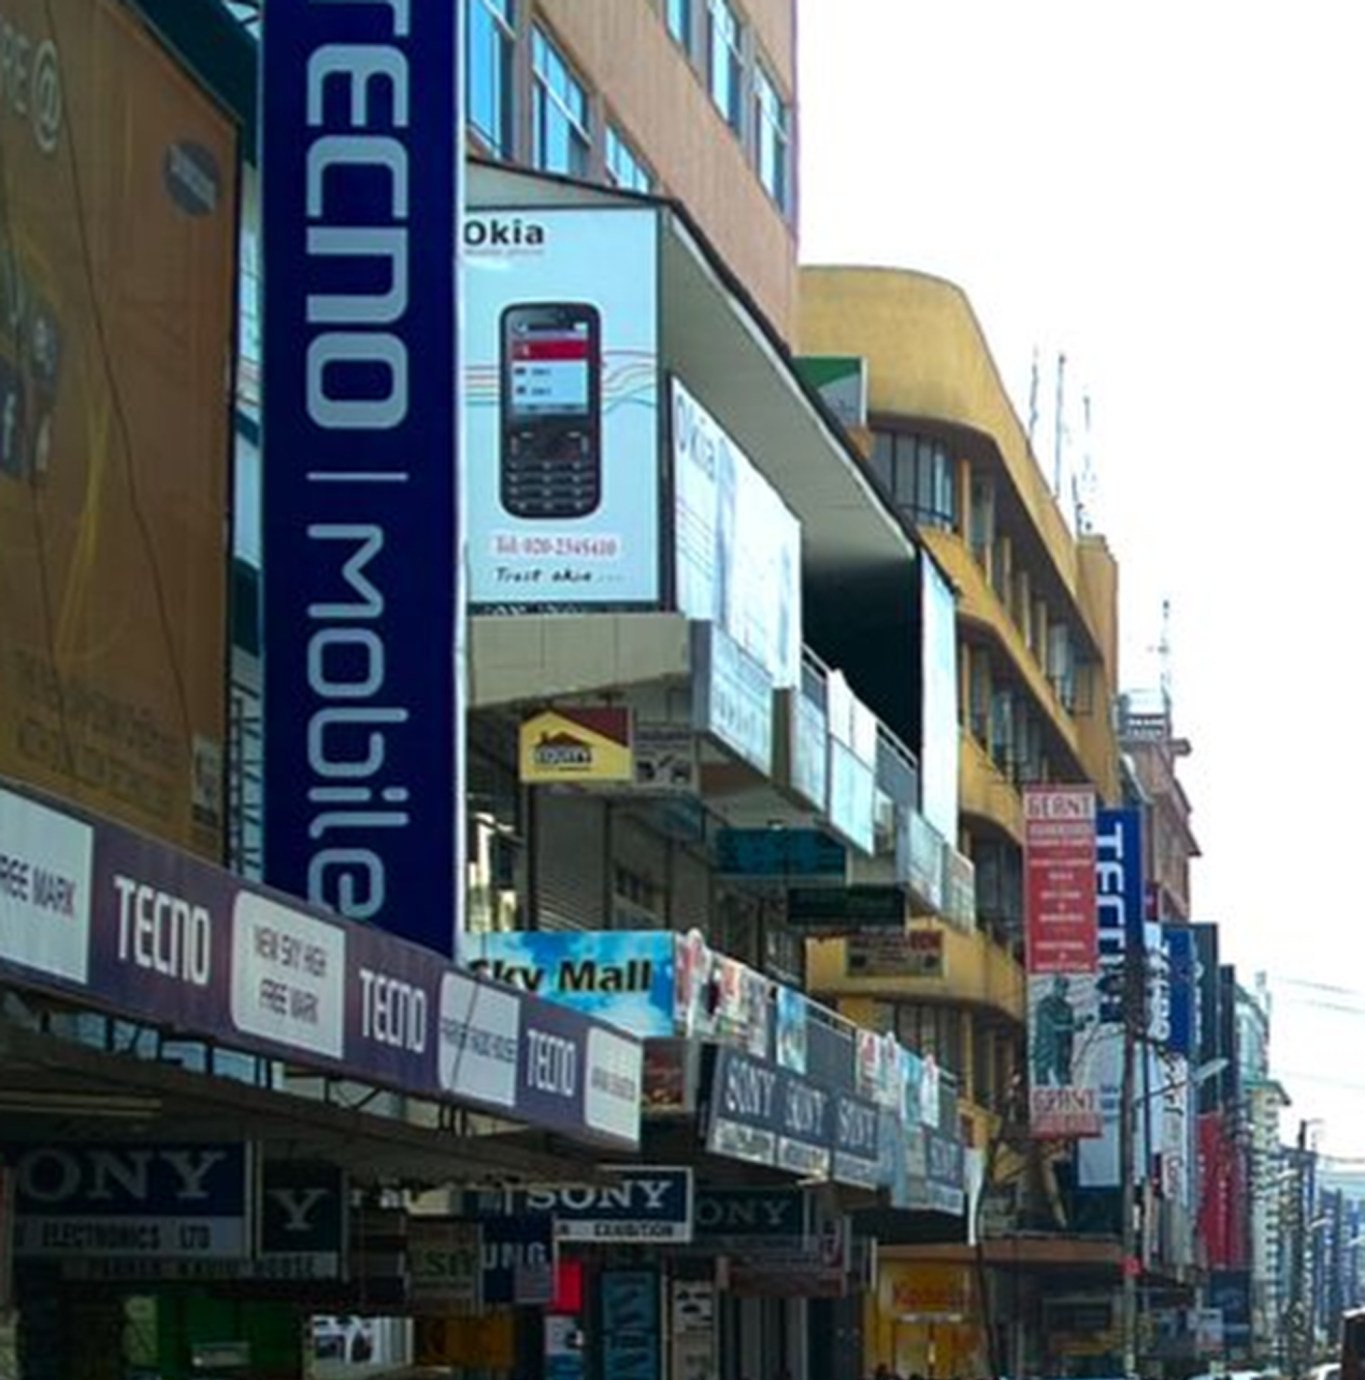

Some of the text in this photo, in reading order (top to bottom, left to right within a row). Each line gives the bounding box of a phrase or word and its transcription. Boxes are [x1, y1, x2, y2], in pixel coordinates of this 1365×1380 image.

[307, 524, 409, 918] Mobile
[114, 875, 210, 985] TECNO
[360, 968, 427, 1054] TECNO
[558, 959, 650, 992] Mall
[528, 1028, 576, 1096] TECNO
